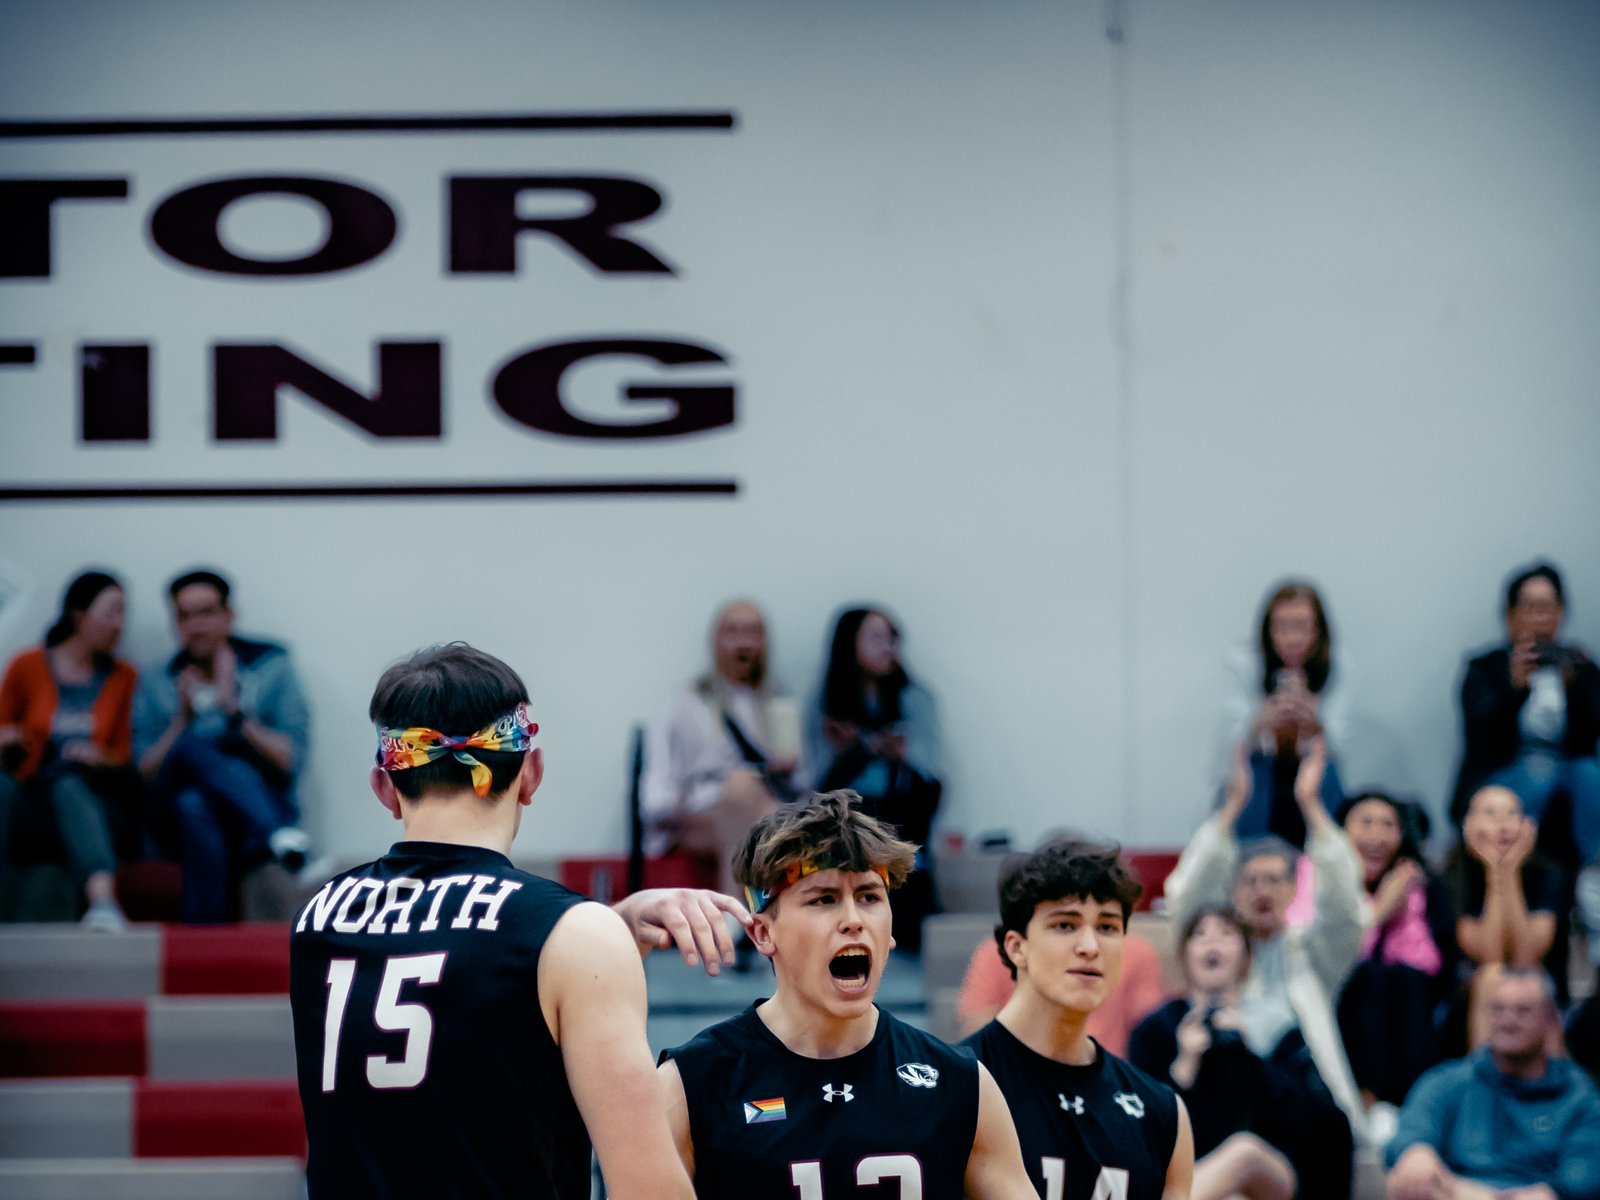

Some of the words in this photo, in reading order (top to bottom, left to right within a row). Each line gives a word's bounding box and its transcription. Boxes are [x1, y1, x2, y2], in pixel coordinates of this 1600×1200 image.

[0, 339, 736, 440] ING
[295, 873, 523, 934] NORTH
[321, 951, 447, 1093] 15
